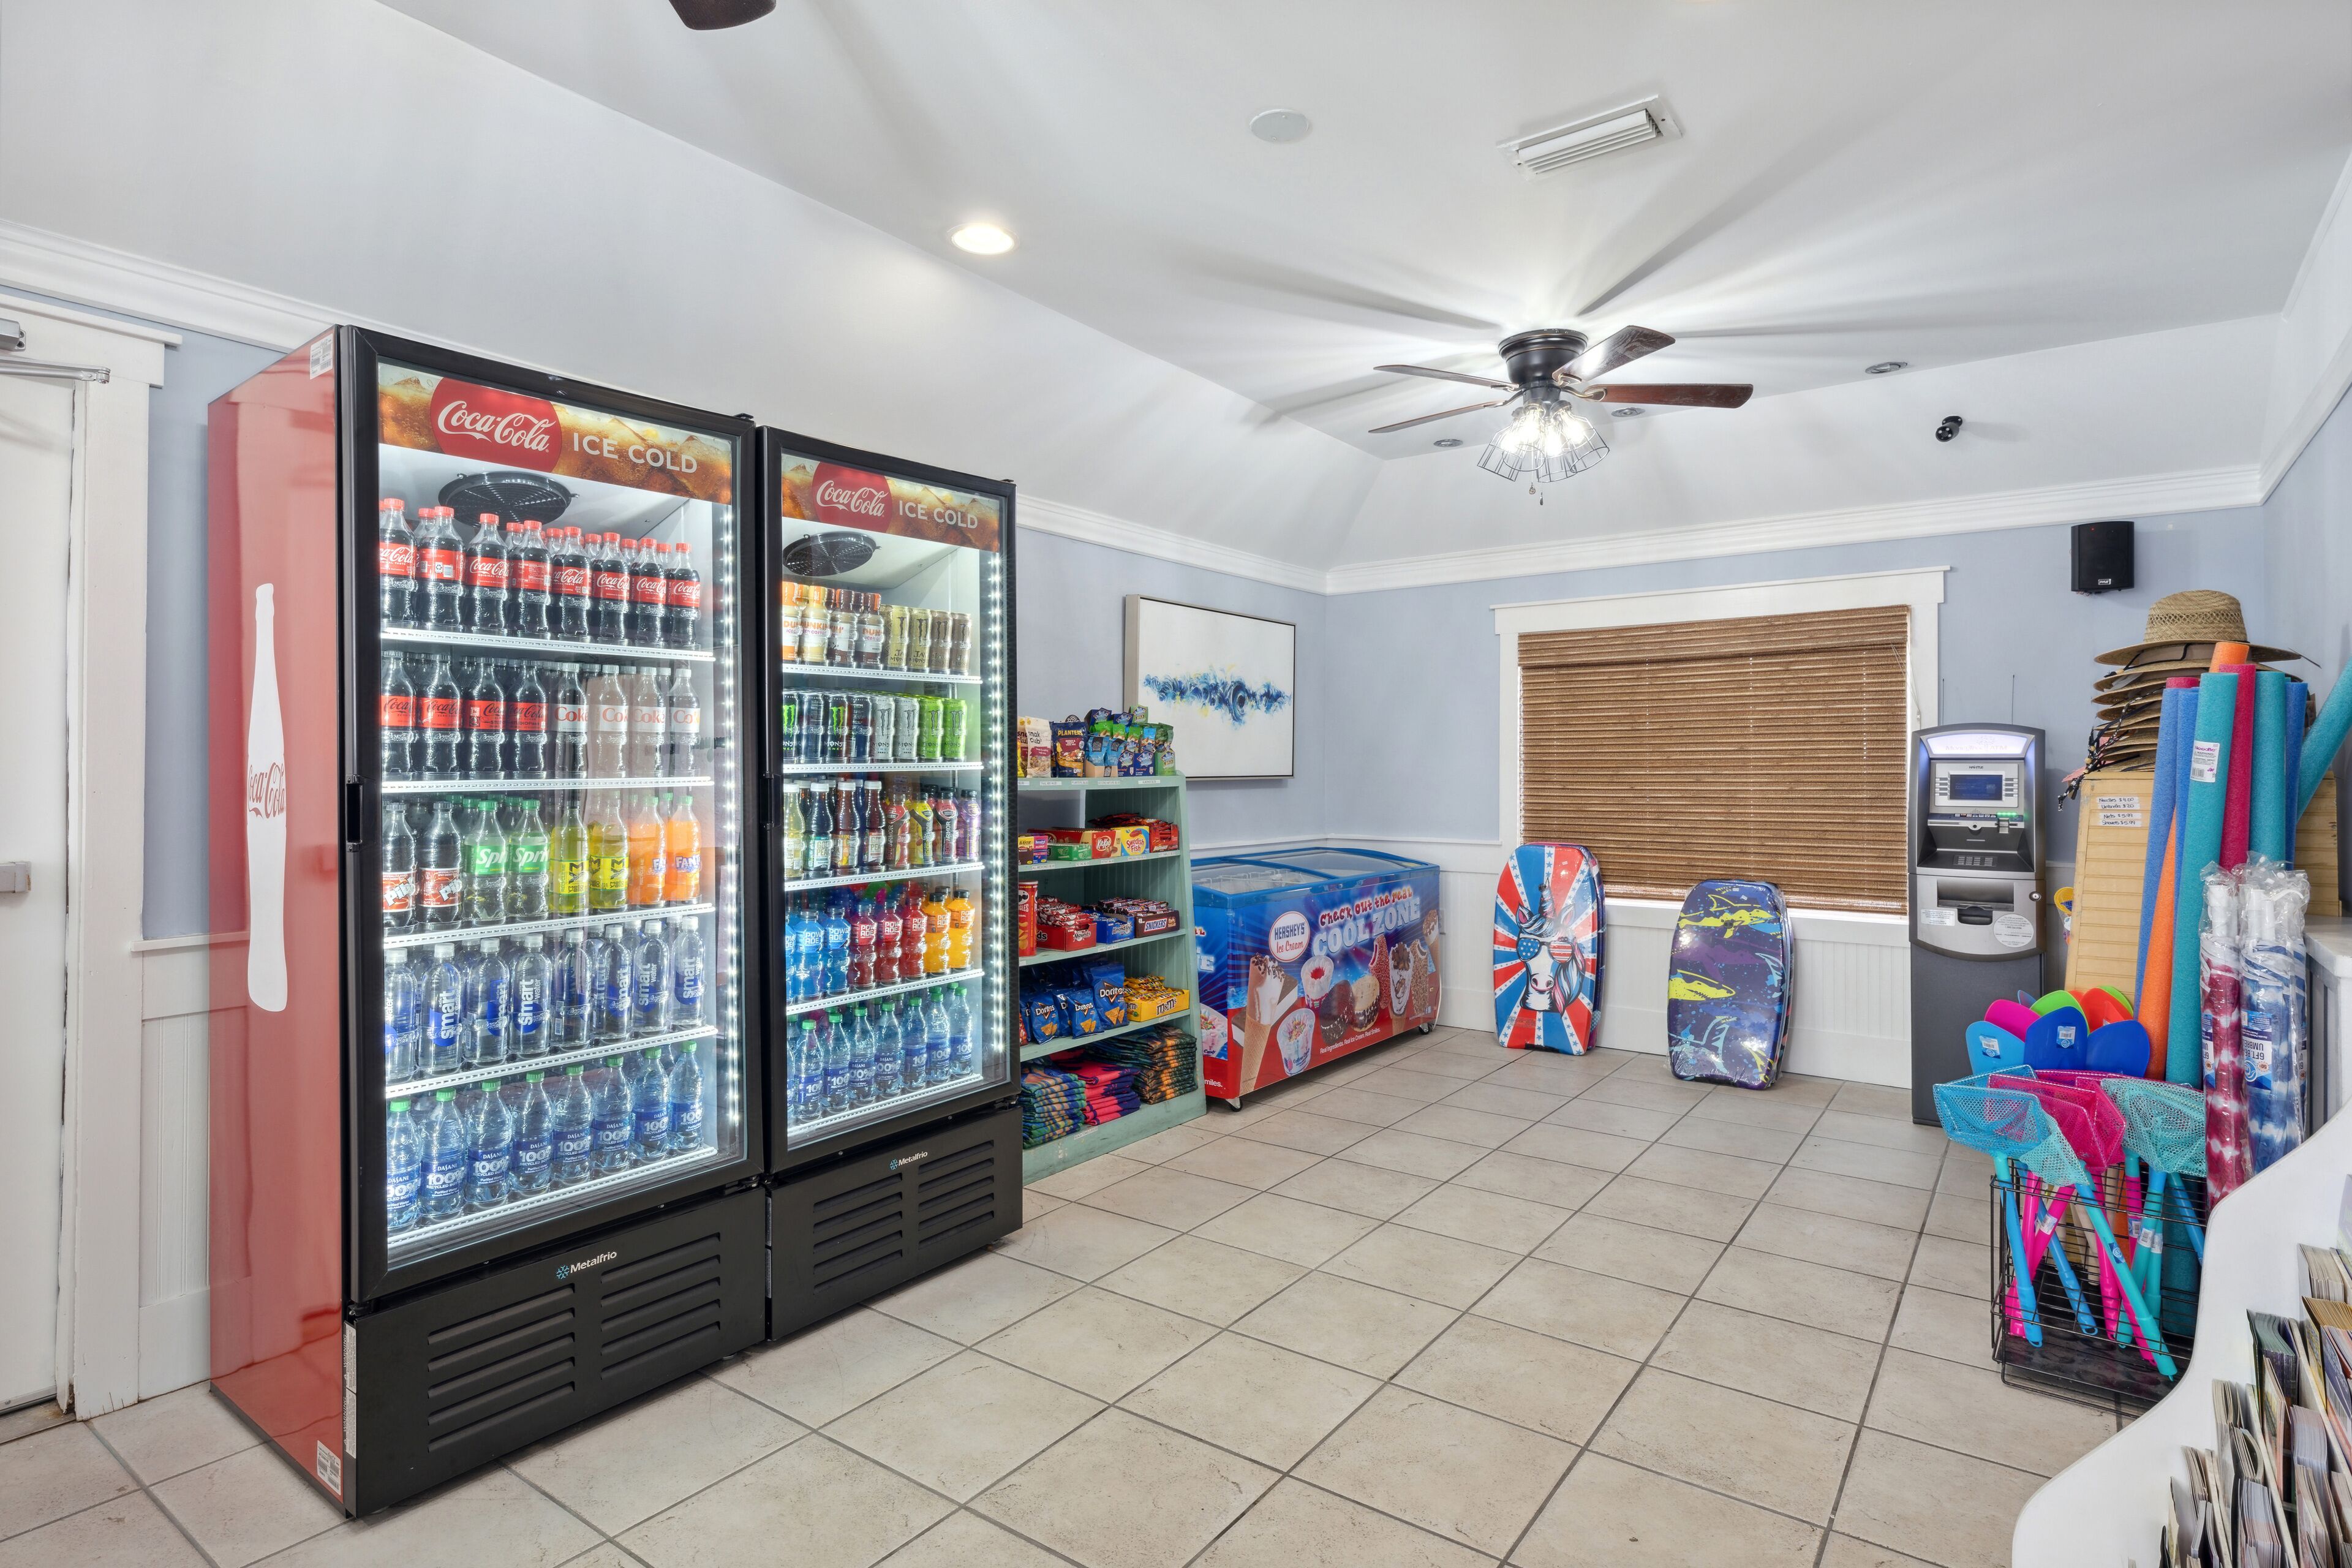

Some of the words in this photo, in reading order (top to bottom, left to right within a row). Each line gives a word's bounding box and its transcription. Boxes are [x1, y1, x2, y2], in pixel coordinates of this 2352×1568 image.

[437, 401, 556, 451] Coca-Cola
[574, 432, 619, 459] ICE
[628, 445, 697, 473] COLD
[816, 480, 888, 517] Coca-Cola
[899, 500, 927, 520] ICE
[934, 507, 978, 529] COLD
[248, 763, 285, 818] Coca-Cola
[1126, 839, 1144, 848] Swedish
[1321, 907, 1352, 926] Check
[1374, 893, 1390, 908] the
[1392, 888, 1412, 903] real
[1145, 919, 1166, 931] SNICKERS
[1274, 922, 1305, 941] HERSHEY'S
[1313, 919, 1369, 957] COOL
[1373, 897, 1420, 935] ZONE
[1286, 940, 1303, 952] Cream
[638, 963, 650, 1006] smart
[683, 957, 696, 998] smart
[440, 990, 454, 1039] smart
[520, 979, 534, 1025] smart
[1035, 1005, 1055, 1015] Doritos
[1075, 1002, 1093, 1011] Doritos
[1327, 1041, 1343, 1052] Ingredients.
[2252, 1051, 2264, 1060] 6FT.
[899, 1152, 927, 1166] Metalfrio
[570, 1251, 617, 1273] Metalfrio
